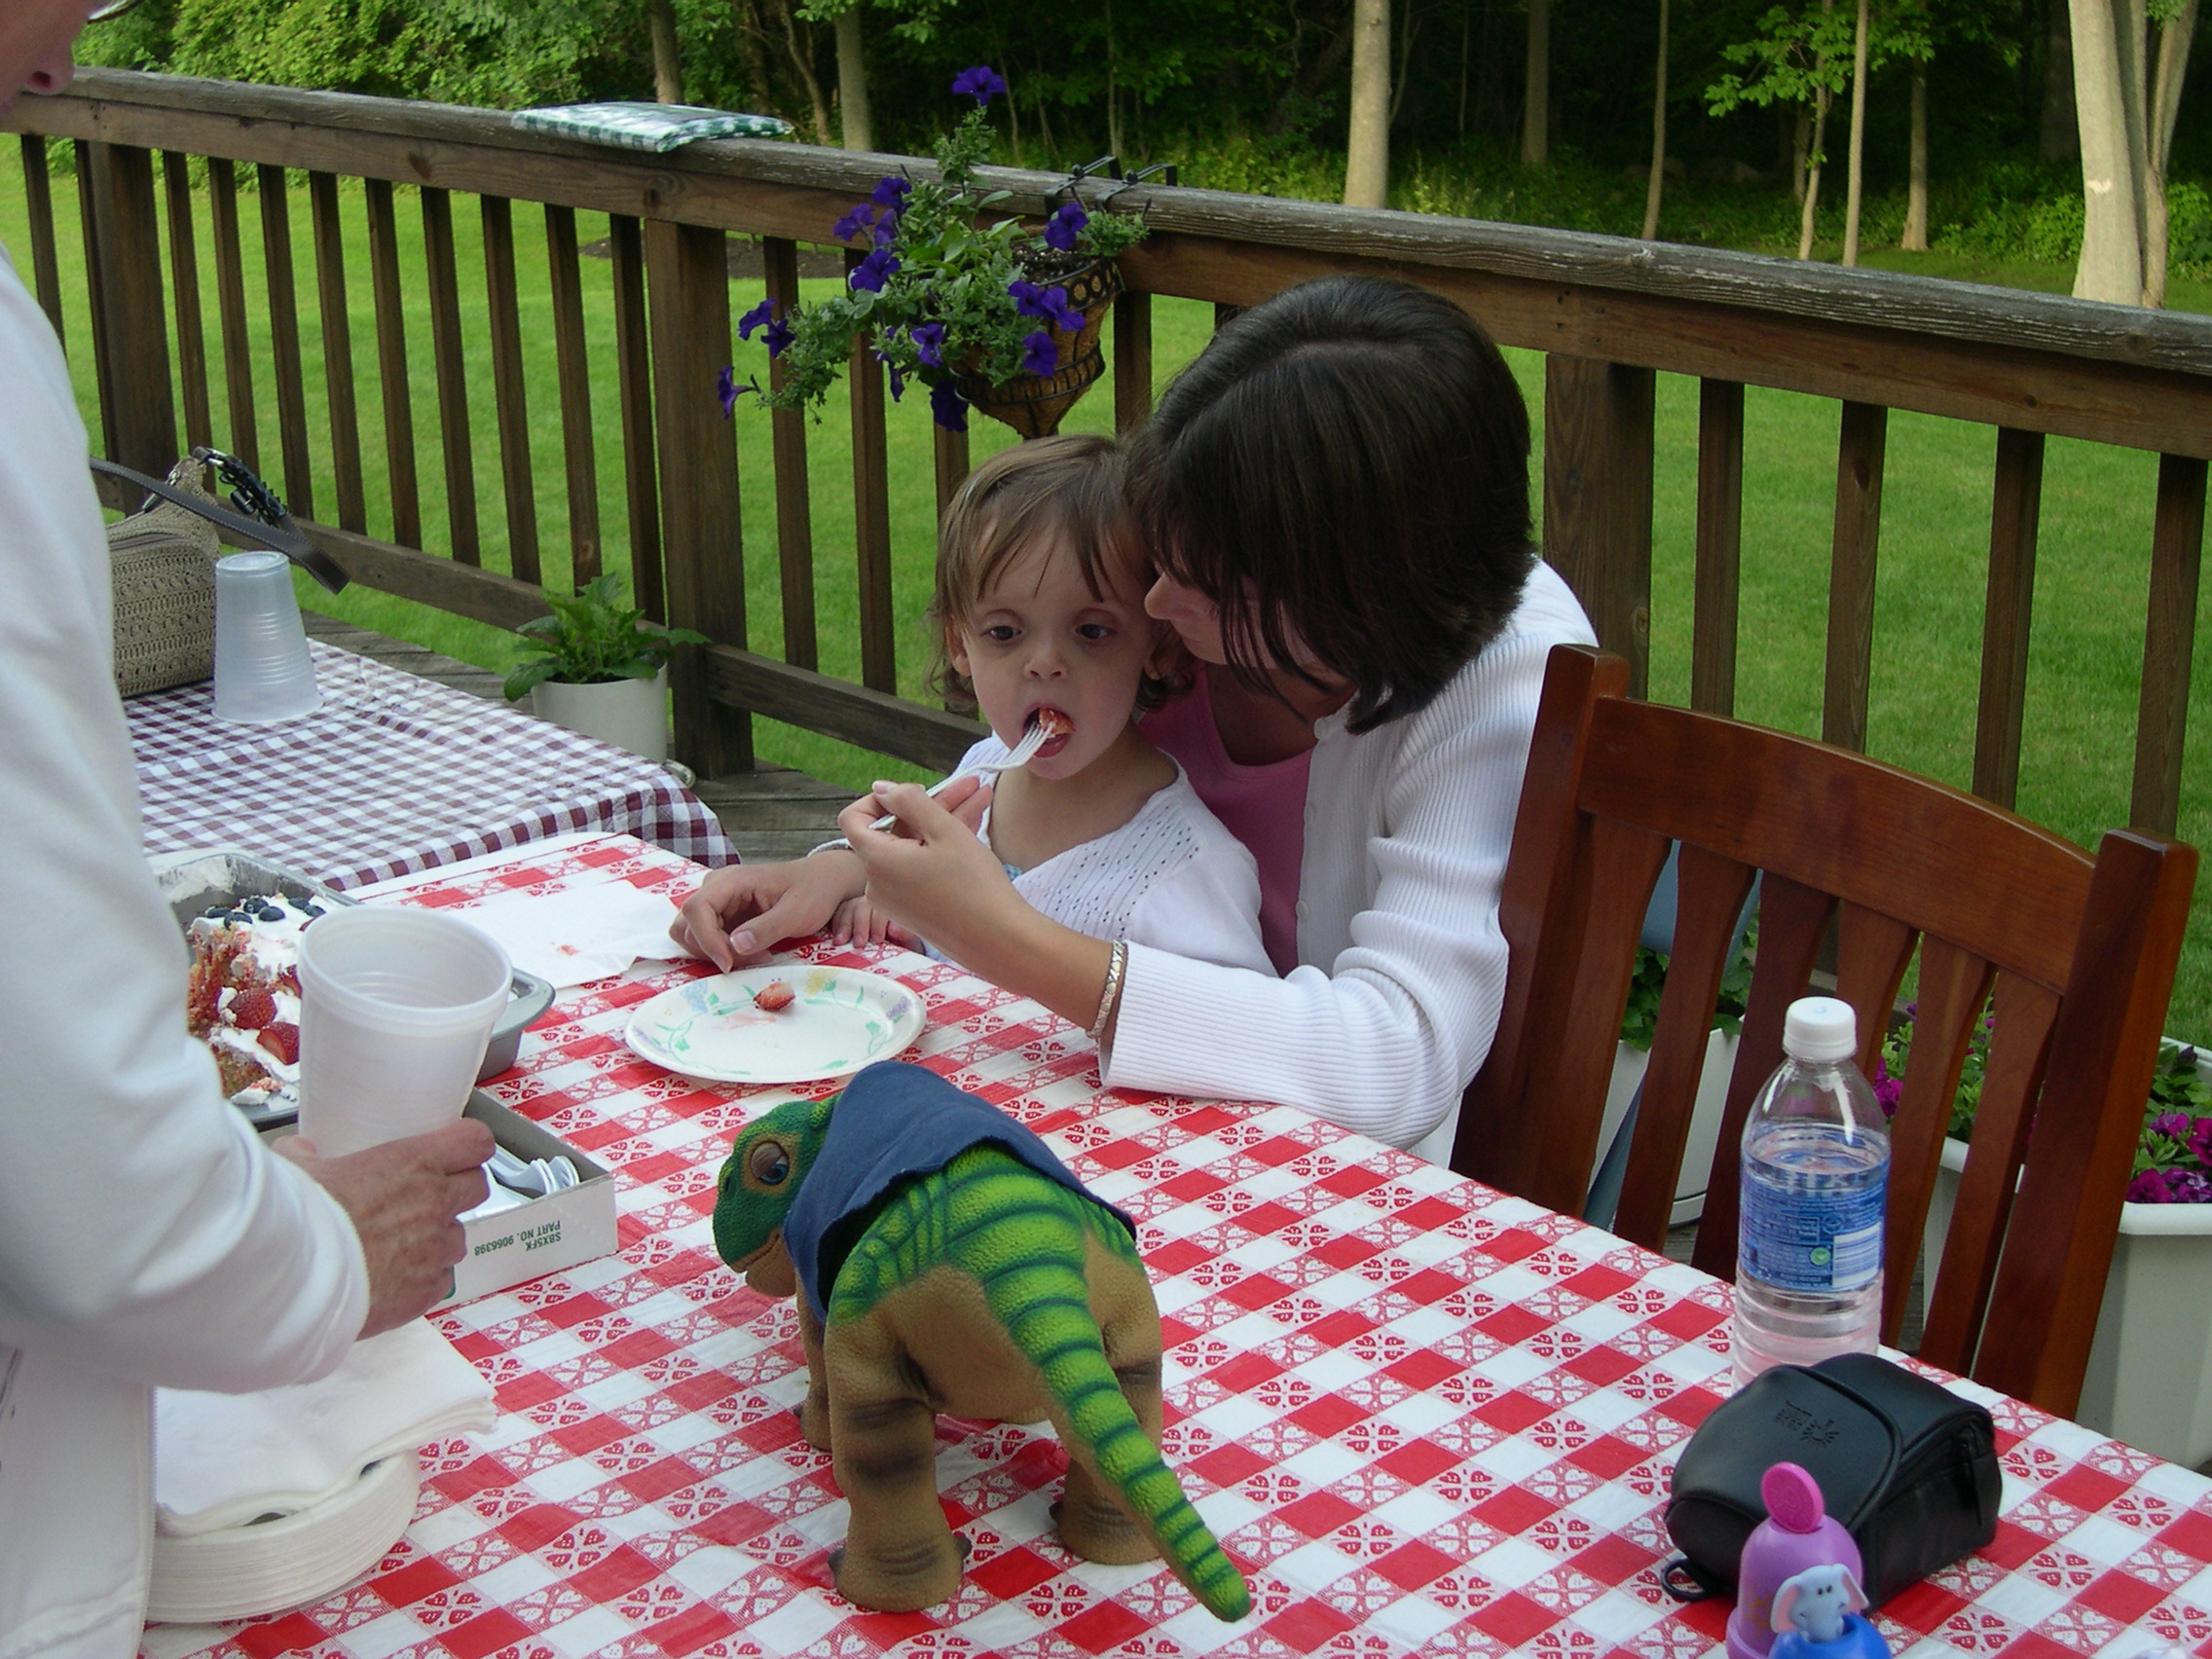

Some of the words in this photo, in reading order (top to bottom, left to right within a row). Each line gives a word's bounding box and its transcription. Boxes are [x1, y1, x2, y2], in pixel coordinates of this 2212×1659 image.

[516, 1229, 535, 1241] NO.
[536, 1220, 561, 1236] PART
[474, 1235, 514, 1256] 9066398
